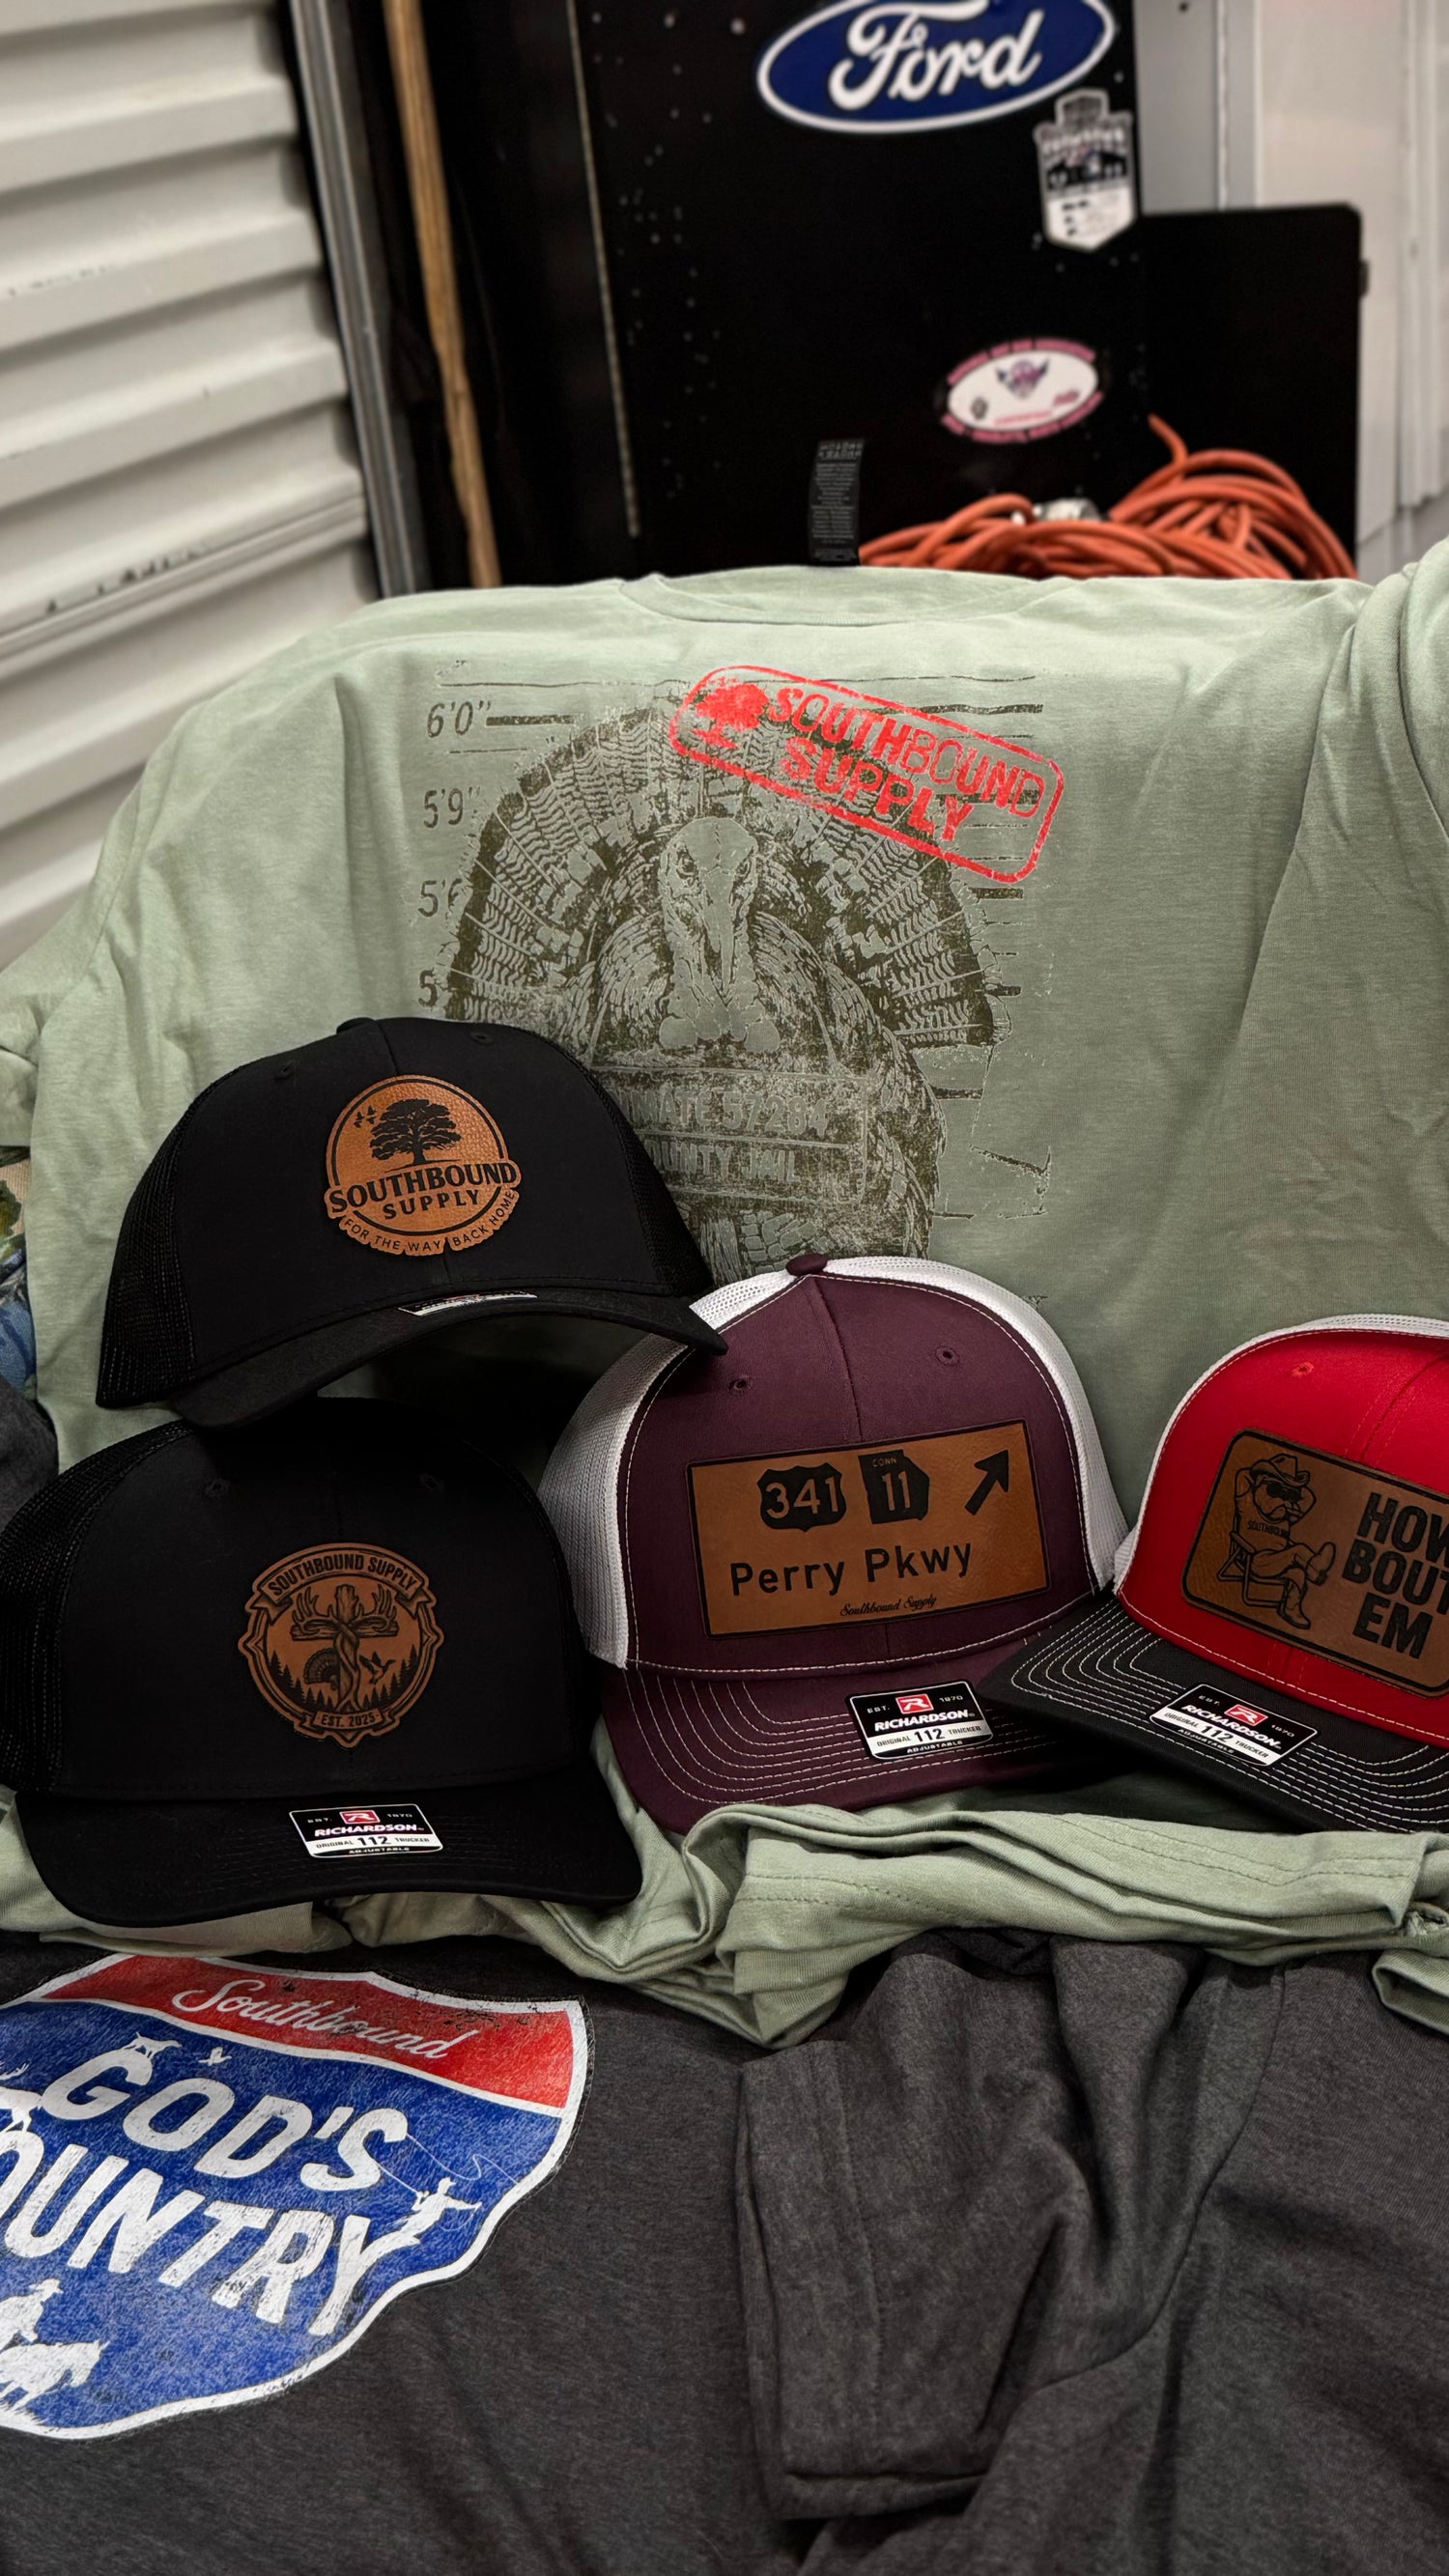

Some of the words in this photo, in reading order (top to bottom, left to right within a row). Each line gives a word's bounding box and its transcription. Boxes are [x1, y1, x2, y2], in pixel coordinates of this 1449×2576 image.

[828, 0, 1044, 110] Ford
[768, 688, 1045, 818] SOUTHBOUND
[781, 736, 974, 840] SUPPLY
[724, 1090, 828, 1137] 57284
[644, 1140, 733, 1175] OUNTY
[329, 1162, 517, 1213] SOUTHBOUND
[383, 1189, 479, 1219] SUPPLY
[344, 1218, 370, 1239] FOR
[375, 1234, 401, 1250] THE
[408, 1240, 441, 1252] WAY
[453, 1226, 489, 1246] BACK
[490, 1191, 516, 1225] HOME
[765, 1477, 838, 1518] 341
[881, 1470, 911, 1512] 11
[269, 1553, 364, 1595] SOUTHBOUND
[368, 1557, 417, 1591] SUPPLY
[730, 1561, 845, 1596] Perry
[865, 1543, 972, 1582] Pkwy
[840, 1599, 901, 1616] Southbound
[903, 1594, 937, 1611] Supply
[1352, 1592, 1434, 1659] EM
[321, 1714, 343, 1727] EST.
[349, 1714, 376, 1727] 2025
[874, 1710, 969, 1732] RICHARDSON
[877, 1736, 911, 1747] ORIGINAL
[914, 1729, 945, 1741] 112
[948, 1726, 981, 1736] TRUCKER
[1164, 1713, 1199, 1727] ORIGINAL
[1201, 1725, 1235, 1742] 112
[1235, 1741, 1269, 1758] TRUCKER
[1181, 1705, 1281, 1747] RICHARDSON
[906, 1741, 963, 1753] ADJUSTABLE
[314, 1825, 417, 1836] RICHARDSON
[316, 1840, 354, 1849] ORIGINAL
[357, 1836, 390, 1846] 112
[172, 1979, 480, 2059] Southbound
[41, 2048, 408, 2191] GOD'S
